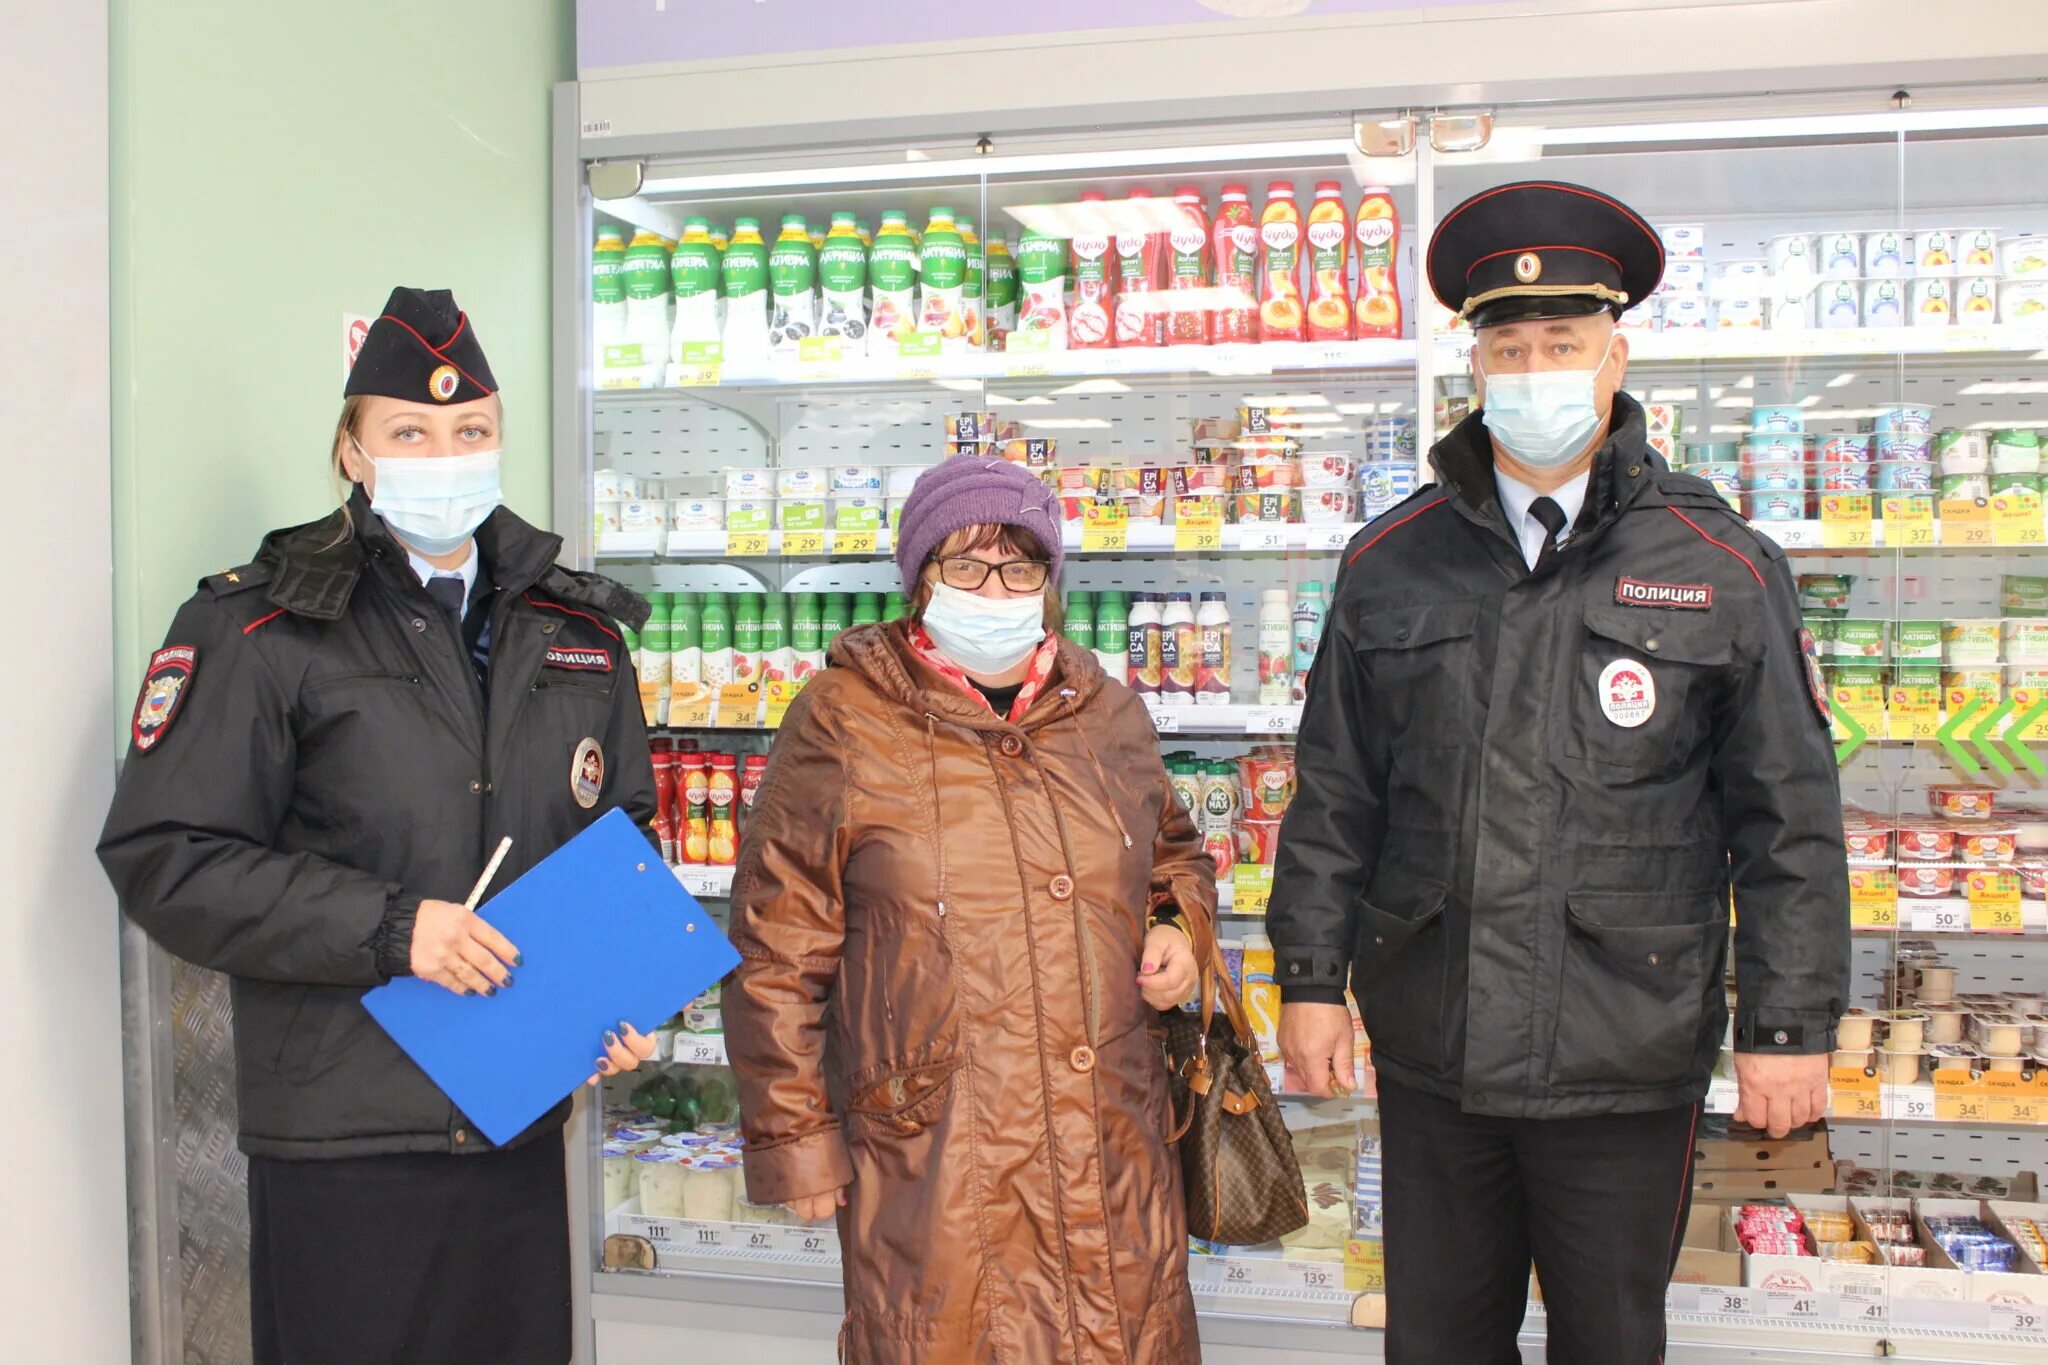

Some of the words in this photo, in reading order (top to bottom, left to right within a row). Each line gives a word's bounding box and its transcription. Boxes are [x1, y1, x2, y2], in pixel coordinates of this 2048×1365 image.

[1197, 535, 1213, 545] 39
[1264, 535, 1278, 545] 51
[1328, 534, 1345, 544] 43
[1784, 532, 1801, 542] 29
[1911, 530, 1927, 540] 37
[1966, 530, 1984, 540] 29
[745, 540, 761, 550] 29
[801, 538, 816, 549] 29
[853, 538, 868, 549] 29
[1103, 536, 1119, 546] 39
[1622, 583, 1706, 602] ПОЛИЦИЯ
[546, 651, 607, 665] ОЛИЦИЯ
[1156, 717, 1171, 727] 57
[1268, 718, 1285, 728] 65
[1211, 791, 1227, 801] BIO
[1208, 800, 1229, 809] MAX
[700, 881, 713, 891] 51
[1872, 910, 1890, 921] 36
[1935, 913, 1954, 925] 50
[1993, 911, 2012, 923] 36
[694, 1047, 709, 1058] 59
[1857, 1100, 1875, 1111] 34
[1907, 1102, 1925, 1113] 59
[1959, 1104, 1977, 1115] 34
[2012, 1105, 2031, 1117] 34
[648, 1226, 665, 1237] 111
[697, 1230, 715, 1241] 111
[750, 1233, 766, 1244] 67
[804, 1237, 820, 1248] 67
[1227, 1266, 1245, 1279] 26
[1303, 1271, 1327, 1284] 139
[1723, 1296, 1742, 1309] 38
[1793, 1299, 1810, 1312] 41
[1865, 1305, 1882, 1317] 41
[2014, 1315, 2034, 1327] 39
